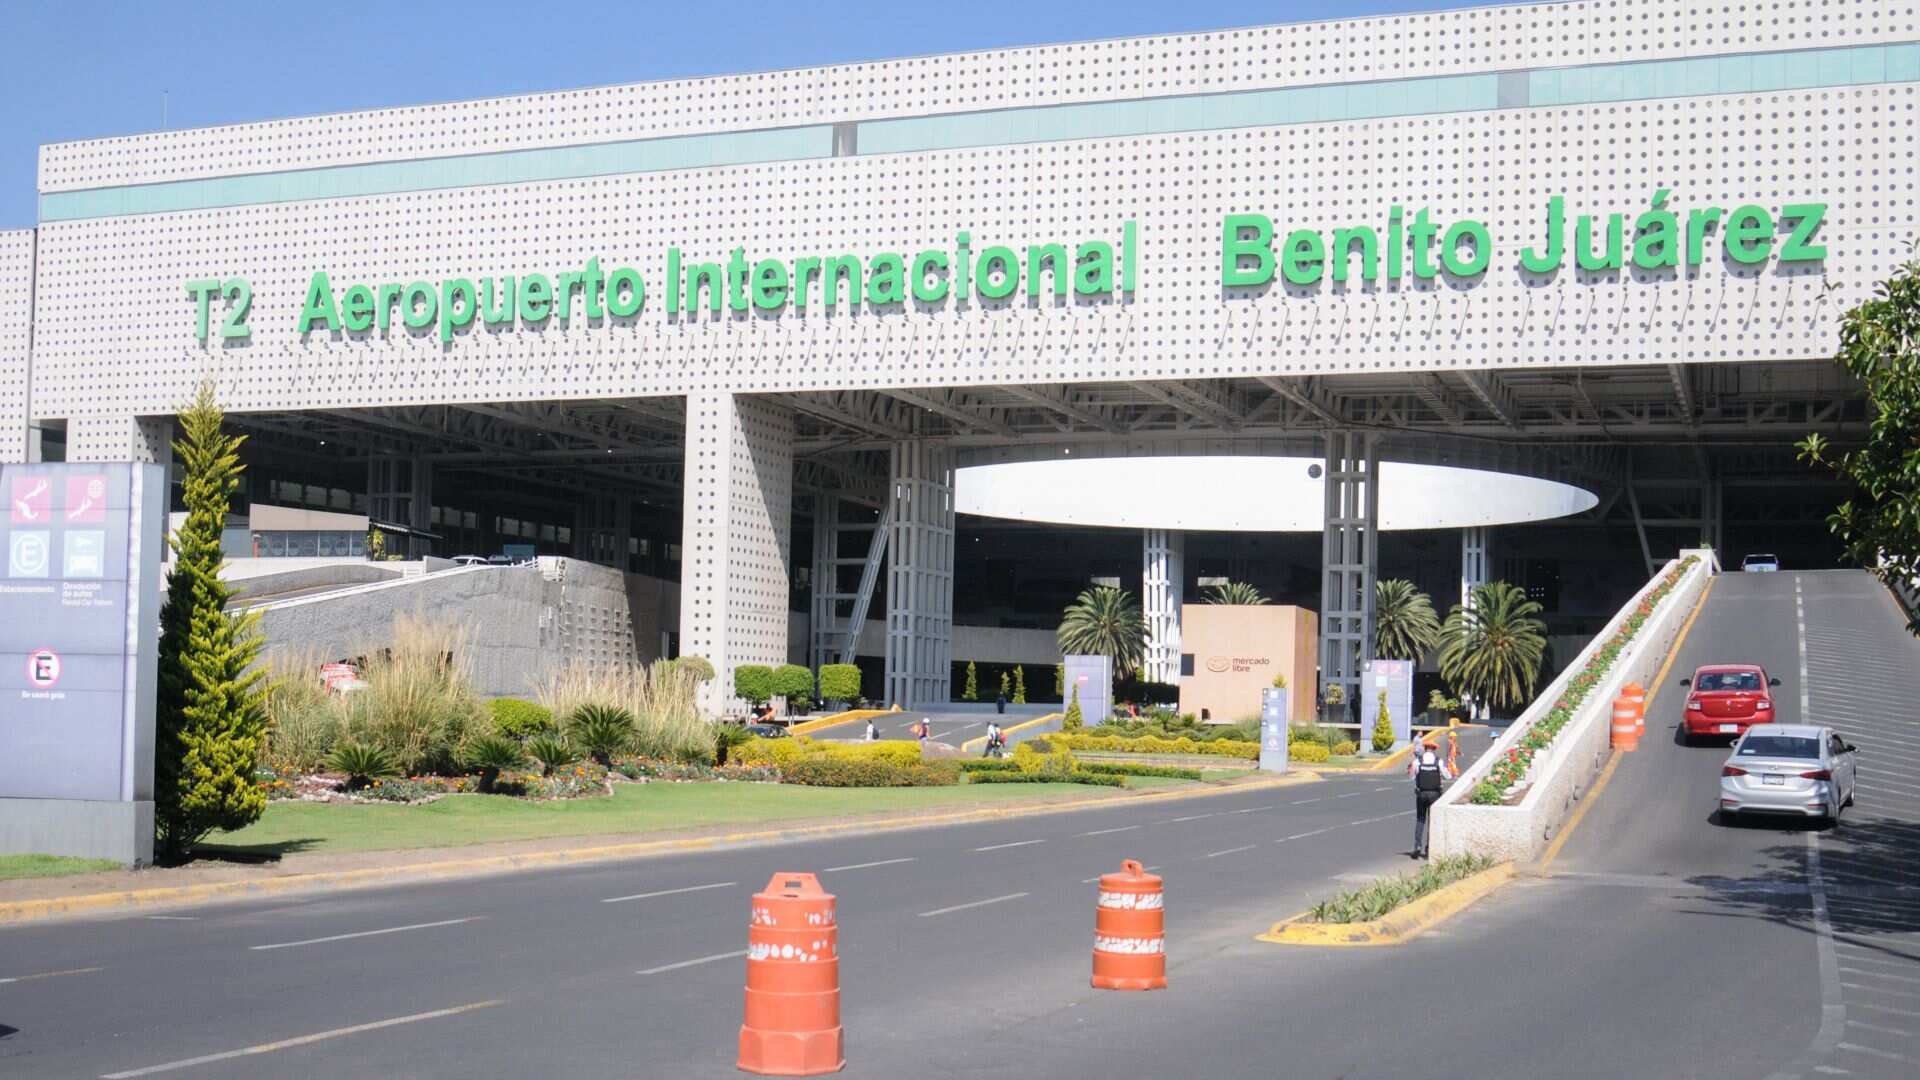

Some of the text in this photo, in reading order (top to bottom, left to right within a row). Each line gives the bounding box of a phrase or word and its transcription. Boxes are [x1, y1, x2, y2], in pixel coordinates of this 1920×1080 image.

[184, 189, 1827, 342] T2 Aeropuerto Internacional Benito Juárez
[1232, 657, 1270, 665] mercado
[1232, 664, 1252, 673] libre
